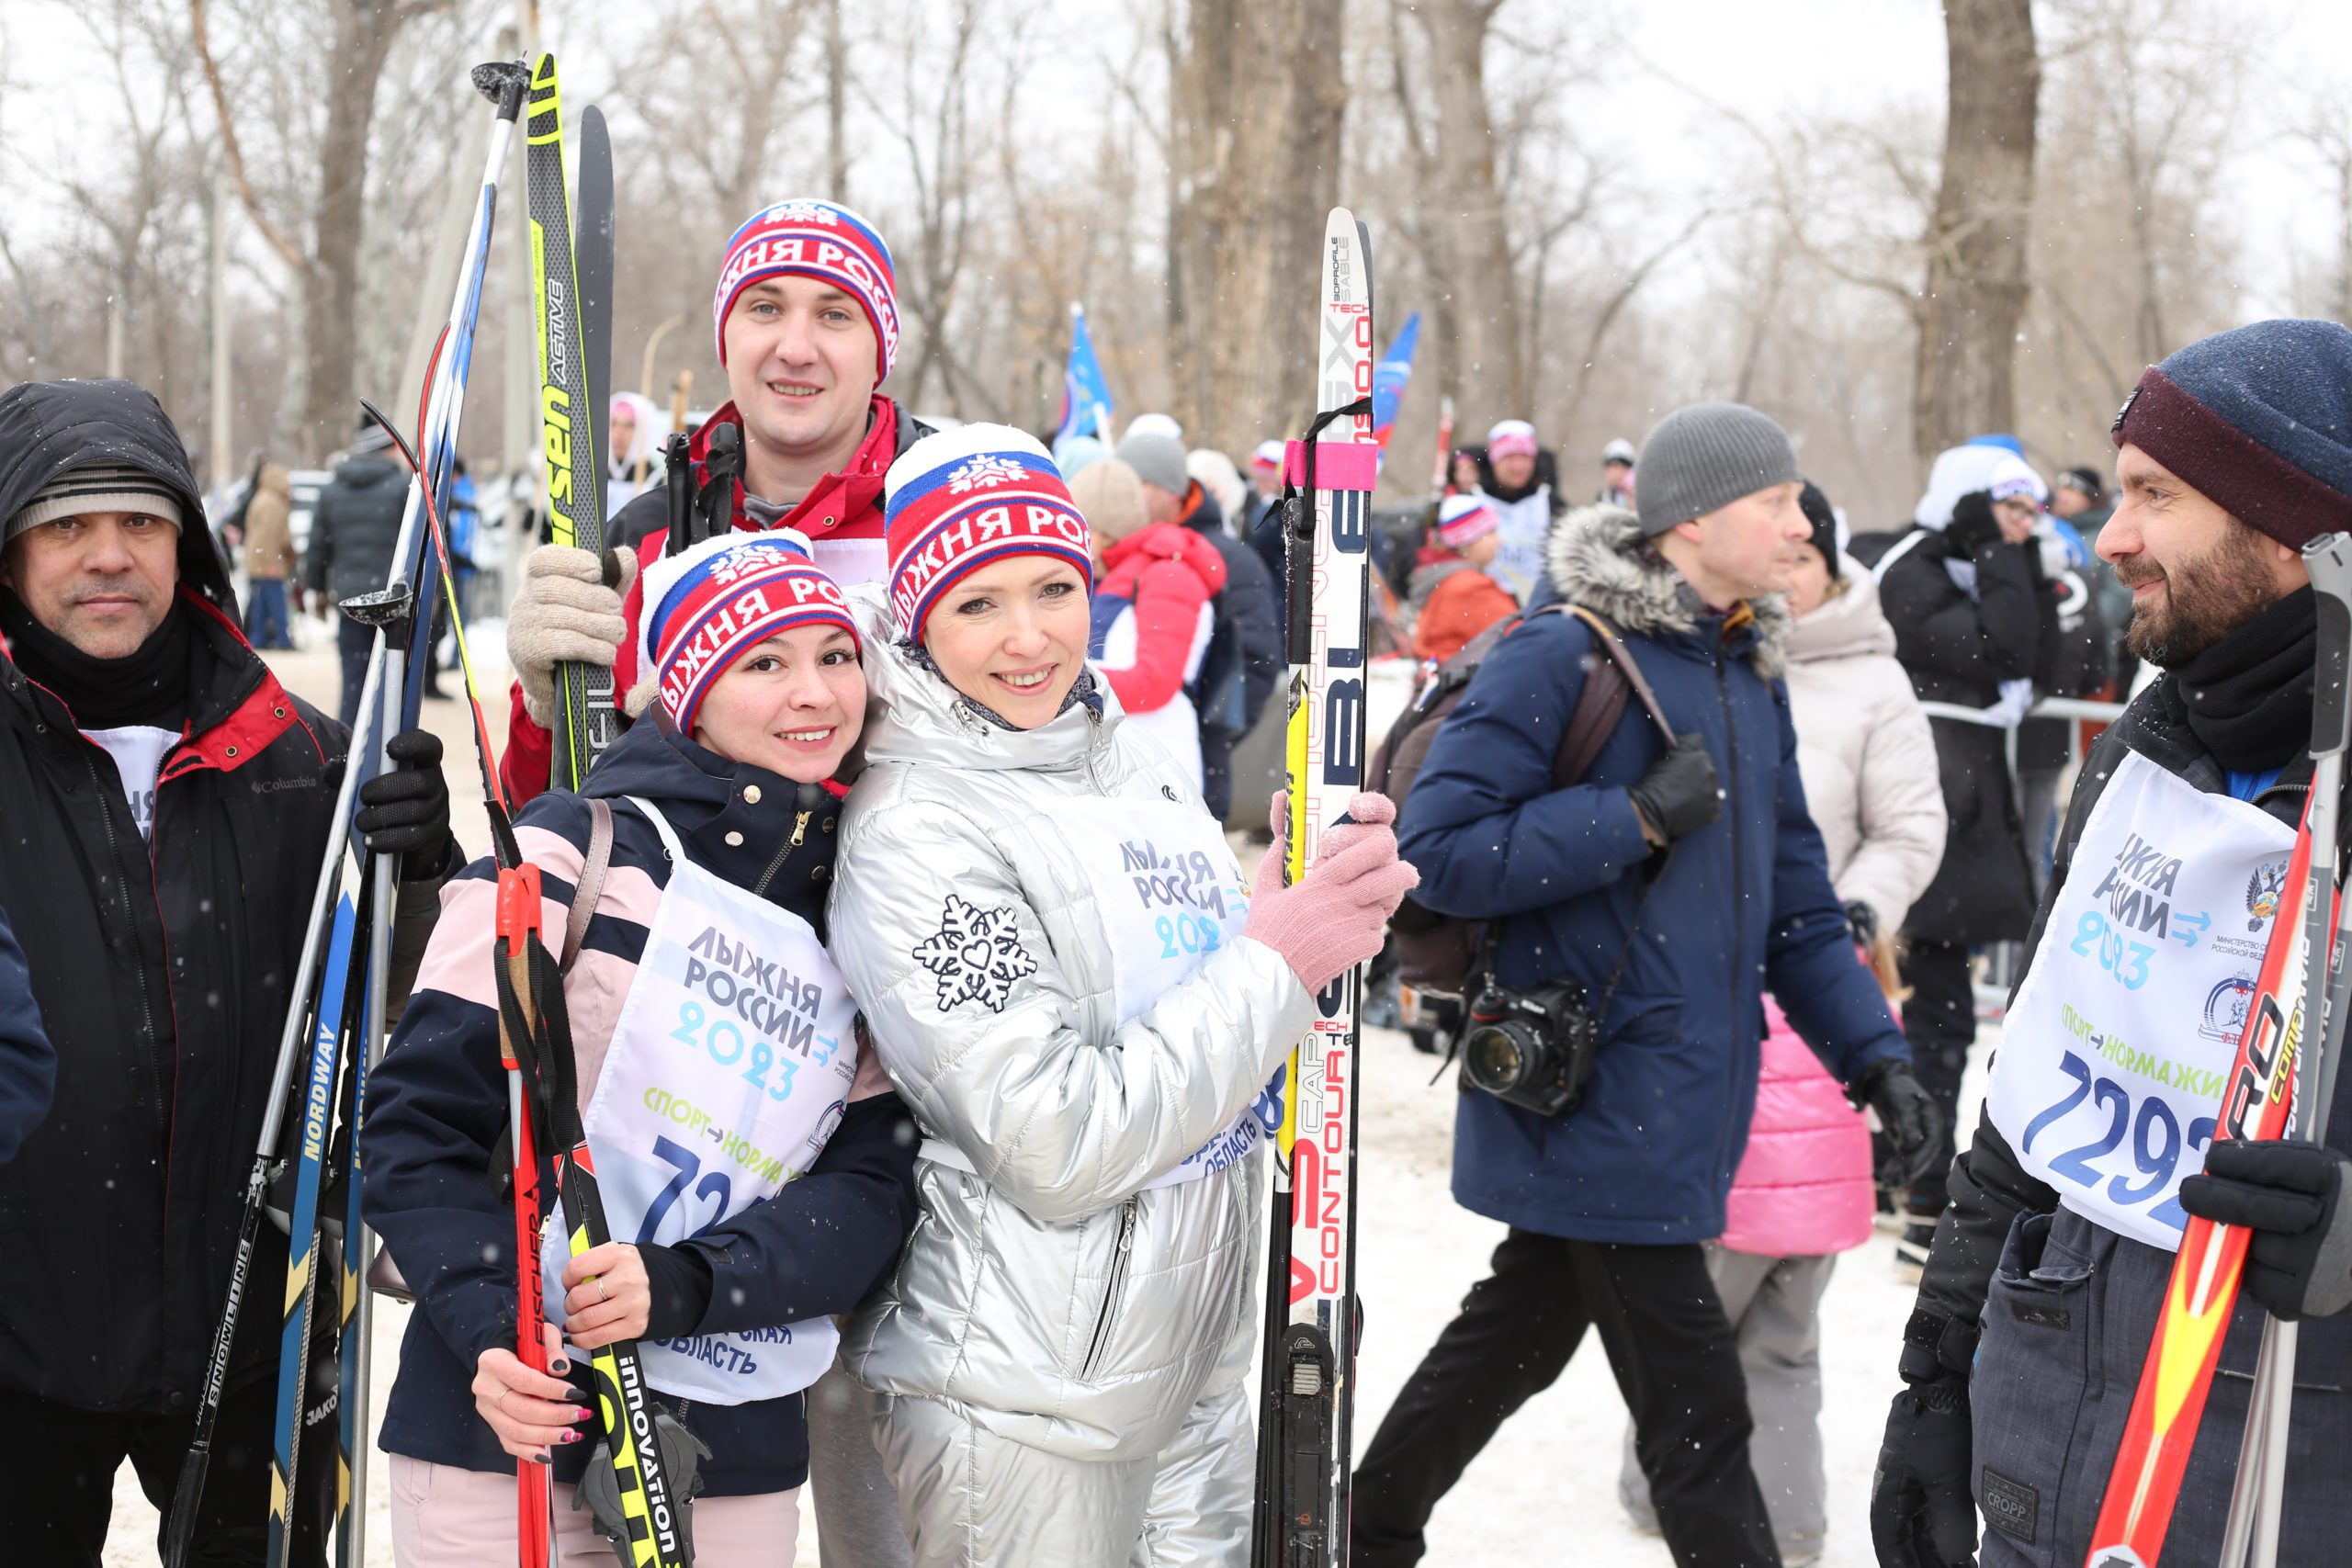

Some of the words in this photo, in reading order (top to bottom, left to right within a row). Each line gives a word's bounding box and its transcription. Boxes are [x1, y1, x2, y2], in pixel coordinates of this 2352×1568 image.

[1330, 236, 1340, 301] 3DPROFILE
[1339, 236, 1351, 302] SABLE
[548, 278, 566, 384] ACTIVE
[661, 588, 771, 713] ЫЖНЯ
[261, 777, 317, 795] Columbia
[687, 925, 823, 1021] ЛЫЖНЯ
[1155, 911, 1221, 959] 202
[668, 1000, 800, 1102] 2023
[684, 956, 815, 1058] РОССИИ
[304, 1021, 335, 1162] NORDWAY
[1301, 1032, 1325, 1134] CAP
[2102, 1033, 2170, 1085] НОРМА
[644, 1087, 712, 1138] СПОРТ
[720, 1130, 786, 1185] НОРМА
[1204, 1117, 1258, 1178] ОБЛАСТЬ
[1319, 1051, 1345, 1295] CONTOUR
[209, 1240, 250, 1406] SNOWLINE
[529, 1213, 546, 1347] FISCHER
[306, 1393, 337, 1427] JAKO
[1987, 1492, 2027, 1517] CROPP
